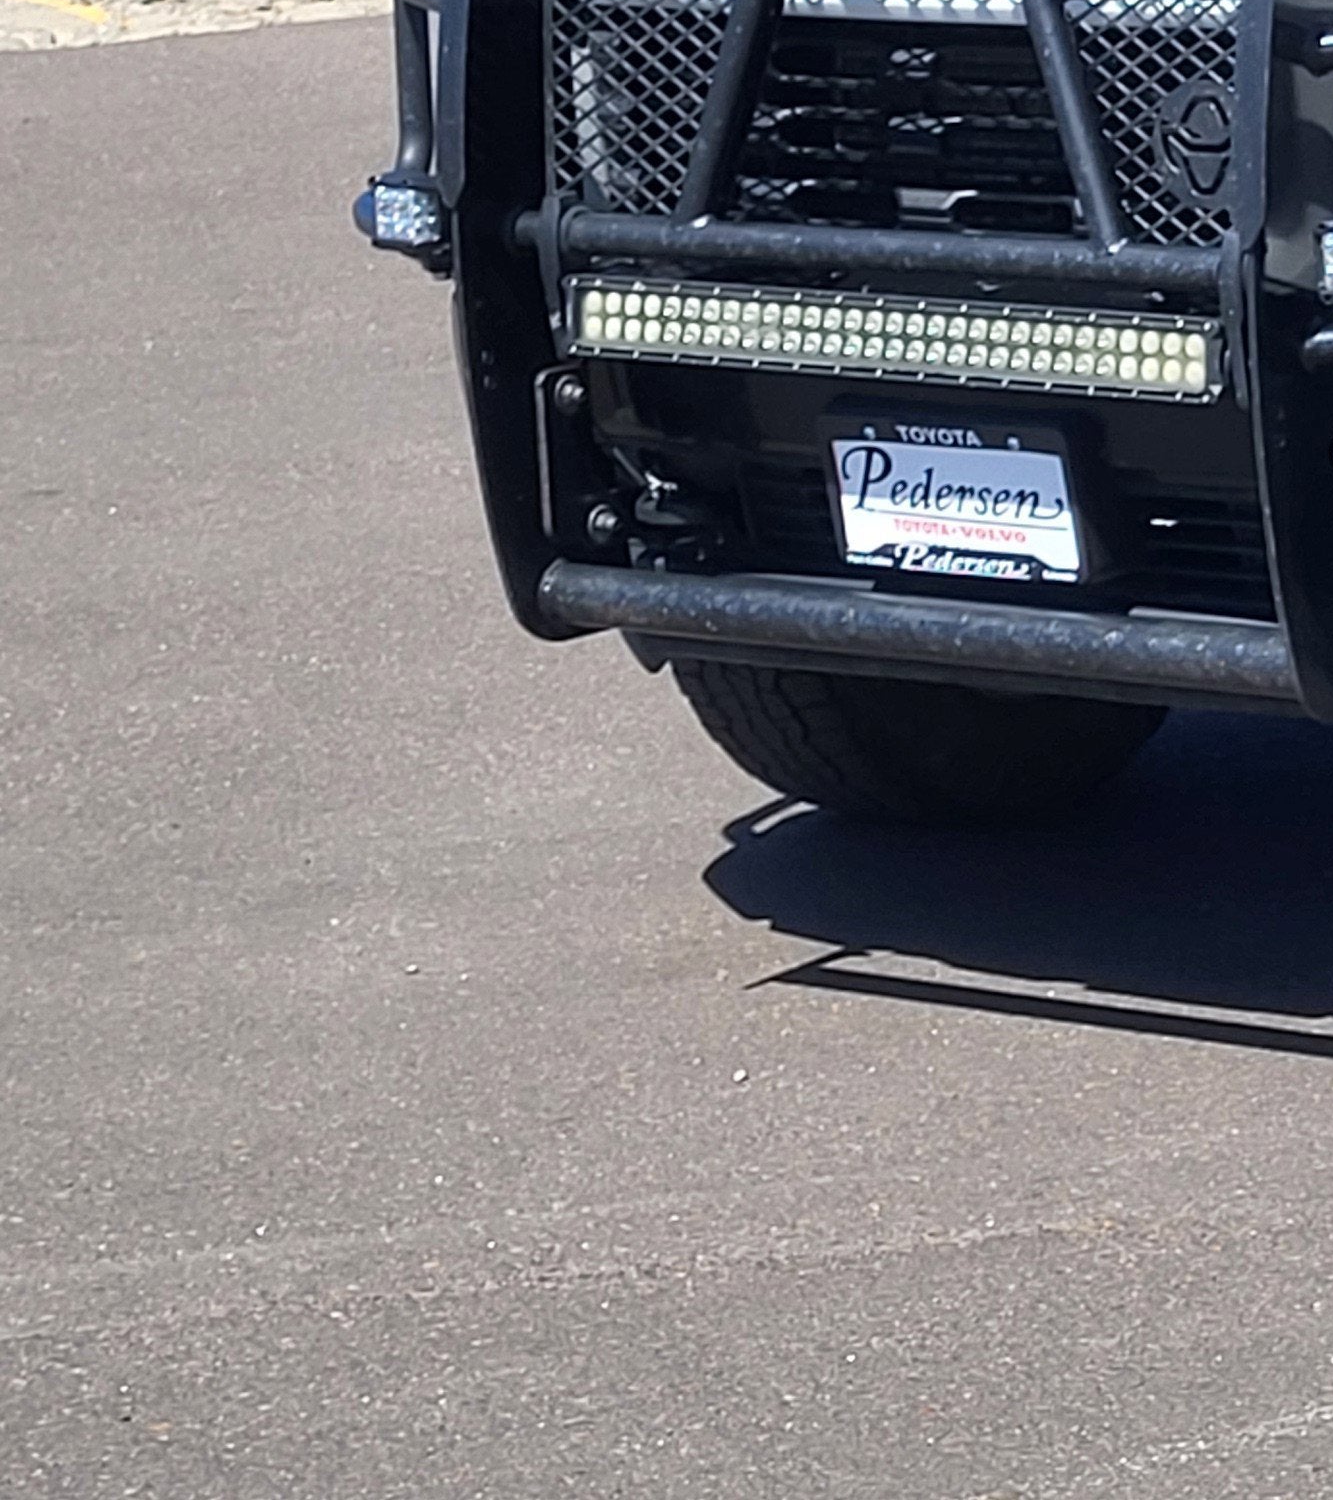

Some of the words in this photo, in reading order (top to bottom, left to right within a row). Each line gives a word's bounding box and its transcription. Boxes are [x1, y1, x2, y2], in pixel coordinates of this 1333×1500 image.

[894, 424, 983, 448] TOYOTA
[841, 444, 1066, 521] Pedersen
[892, 541, 1032, 580] Pedersen
